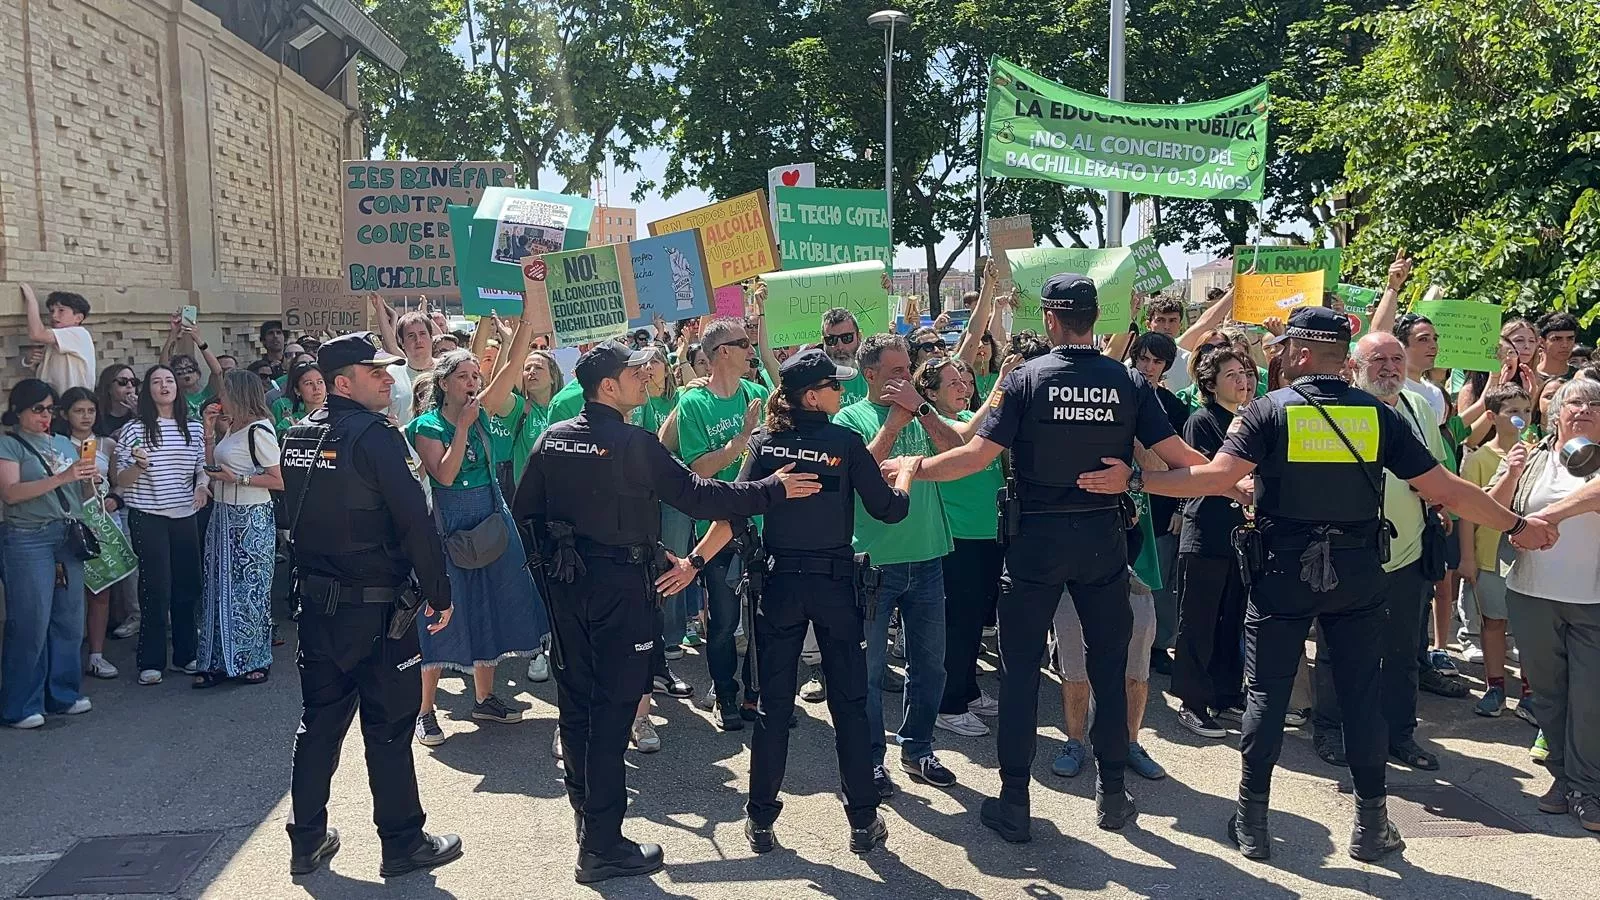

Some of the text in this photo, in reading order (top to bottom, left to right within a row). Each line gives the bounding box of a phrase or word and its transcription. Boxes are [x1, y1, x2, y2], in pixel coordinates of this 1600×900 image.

[1015, 99, 1043, 119] LA
[1029, 130, 1235, 166] ¡NO AL CONCIERTO DEL
[348, 162, 507, 189] IES BINÉFAR
[1005, 151, 1252, 191] BACHILLERATO Y 0-3 AÑOS!
[687, 208, 726, 229] TODOS
[729, 196, 759, 215] LADOS
[778, 203, 795, 223] EL
[798, 204, 841, 225] TECHO
[409, 244, 450, 260] DEL
[781, 239, 798, 260] LA
[800, 234, 851, 263] PÚBLICA
[562, 254, 599, 284] NO!
[721, 254, 768, 279] PELEA
[1146, 256, 1162, 272] NO
[552, 289, 564, 303] AL
[564, 280, 619, 301] CONCIERTO
[553, 295, 623, 318] EDUCATIVO EN
[554, 310, 625, 333] BACHILLERATO
[773, 331, 790, 344] CRA
[1048, 386, 1120, 404] POLICIA
[1053, 406, 1114, 422] HUESCA
[1295, 417, 1373, 433] POLCIA
[285, 448, 324, 460] POLICA
[544, 440, 600, 455] POLICIA
[761, 445, 830, 465] POLICIA
[1302, 438, 1367, 452] HUESA
